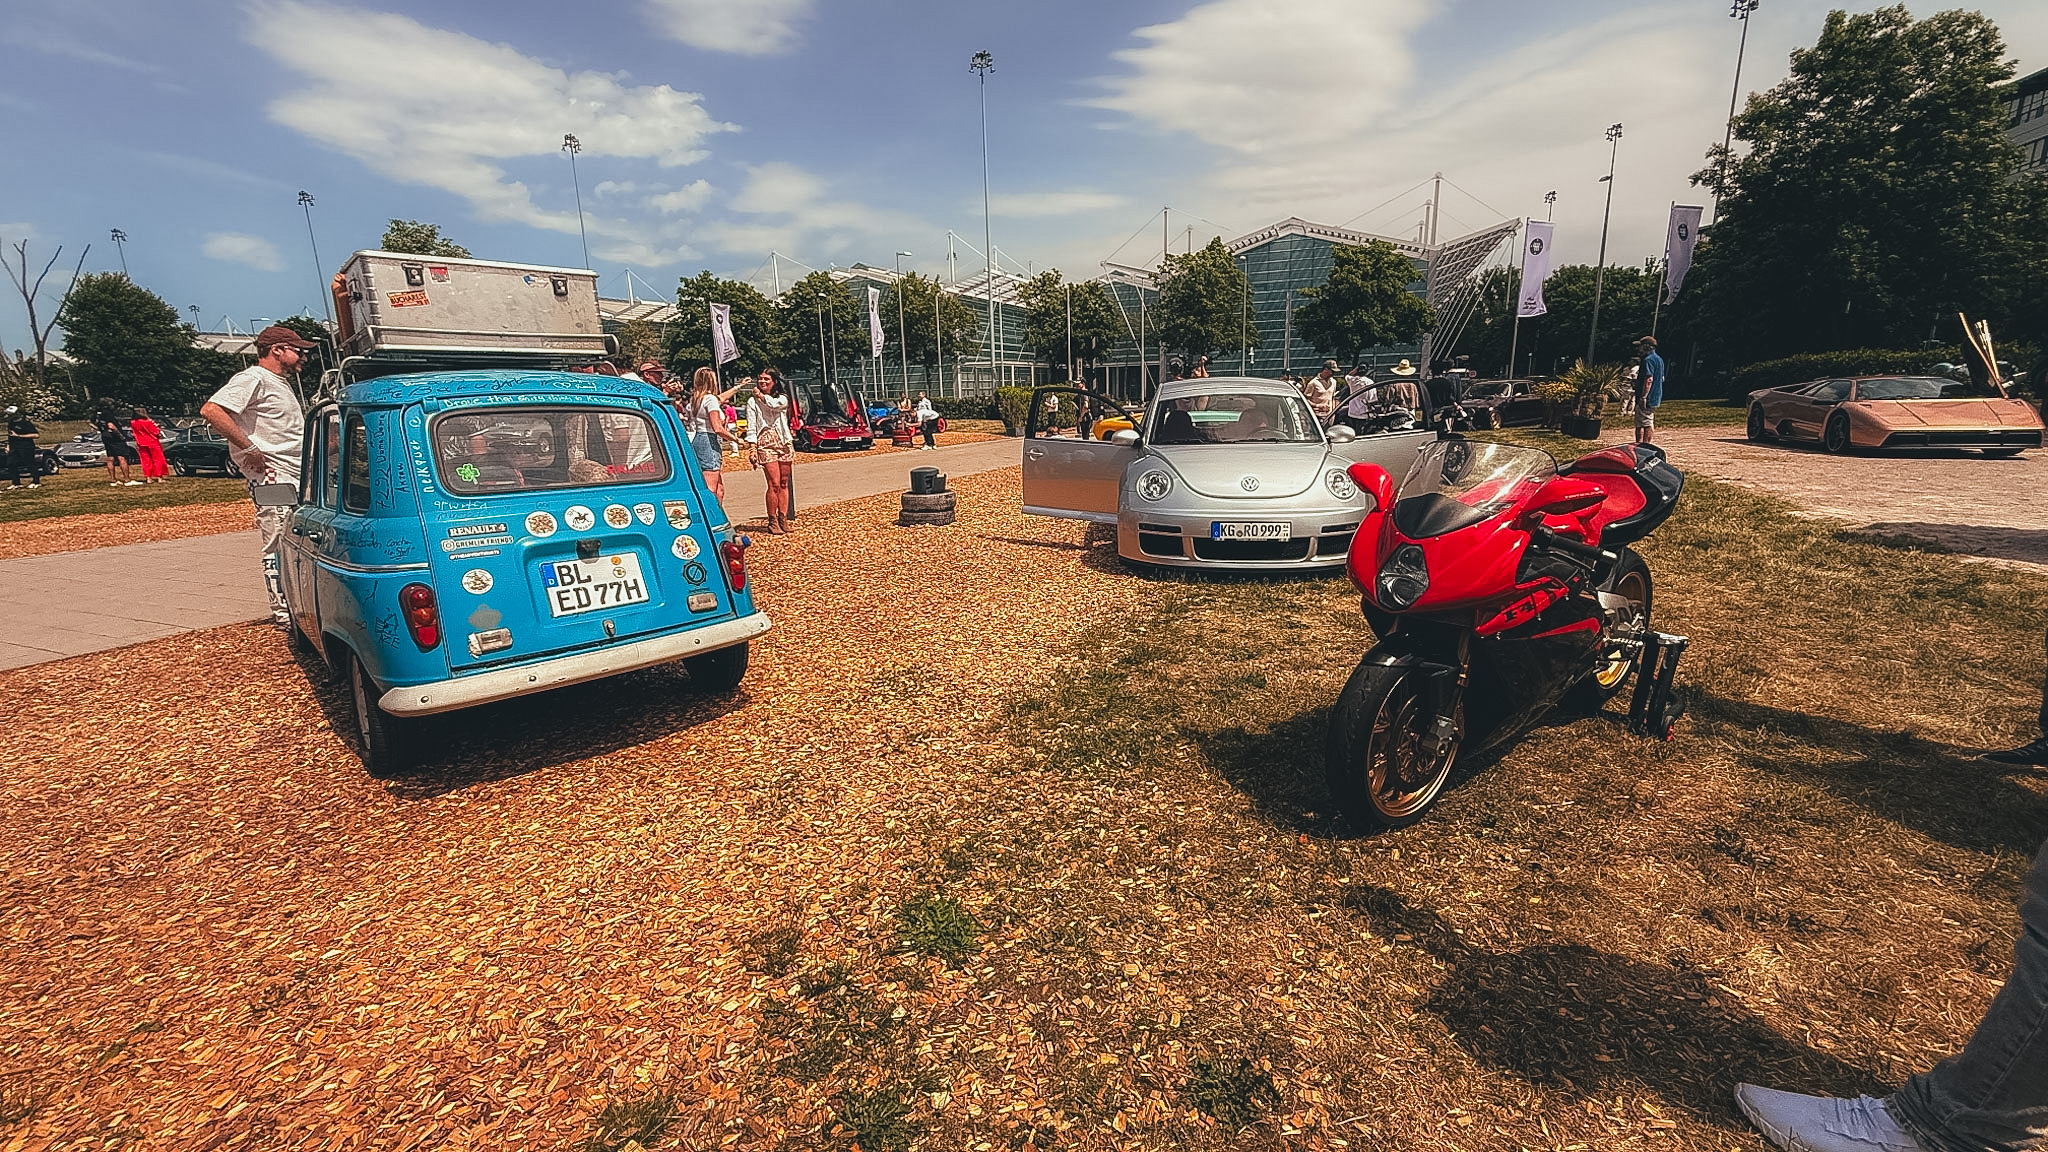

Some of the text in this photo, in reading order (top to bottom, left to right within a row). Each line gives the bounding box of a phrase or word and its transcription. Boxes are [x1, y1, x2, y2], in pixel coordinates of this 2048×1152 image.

[449, 523, 507, 537] RENAULT 4
[1220, 524, 1282, 537] KG RO 999
[456, 536, 513, 548] GREMLIN FRIENDS
[557, 563, 592, 587] BL
[556, 578, 642, 612] ED 77H
[1503, 602, 1535, 624] F4
